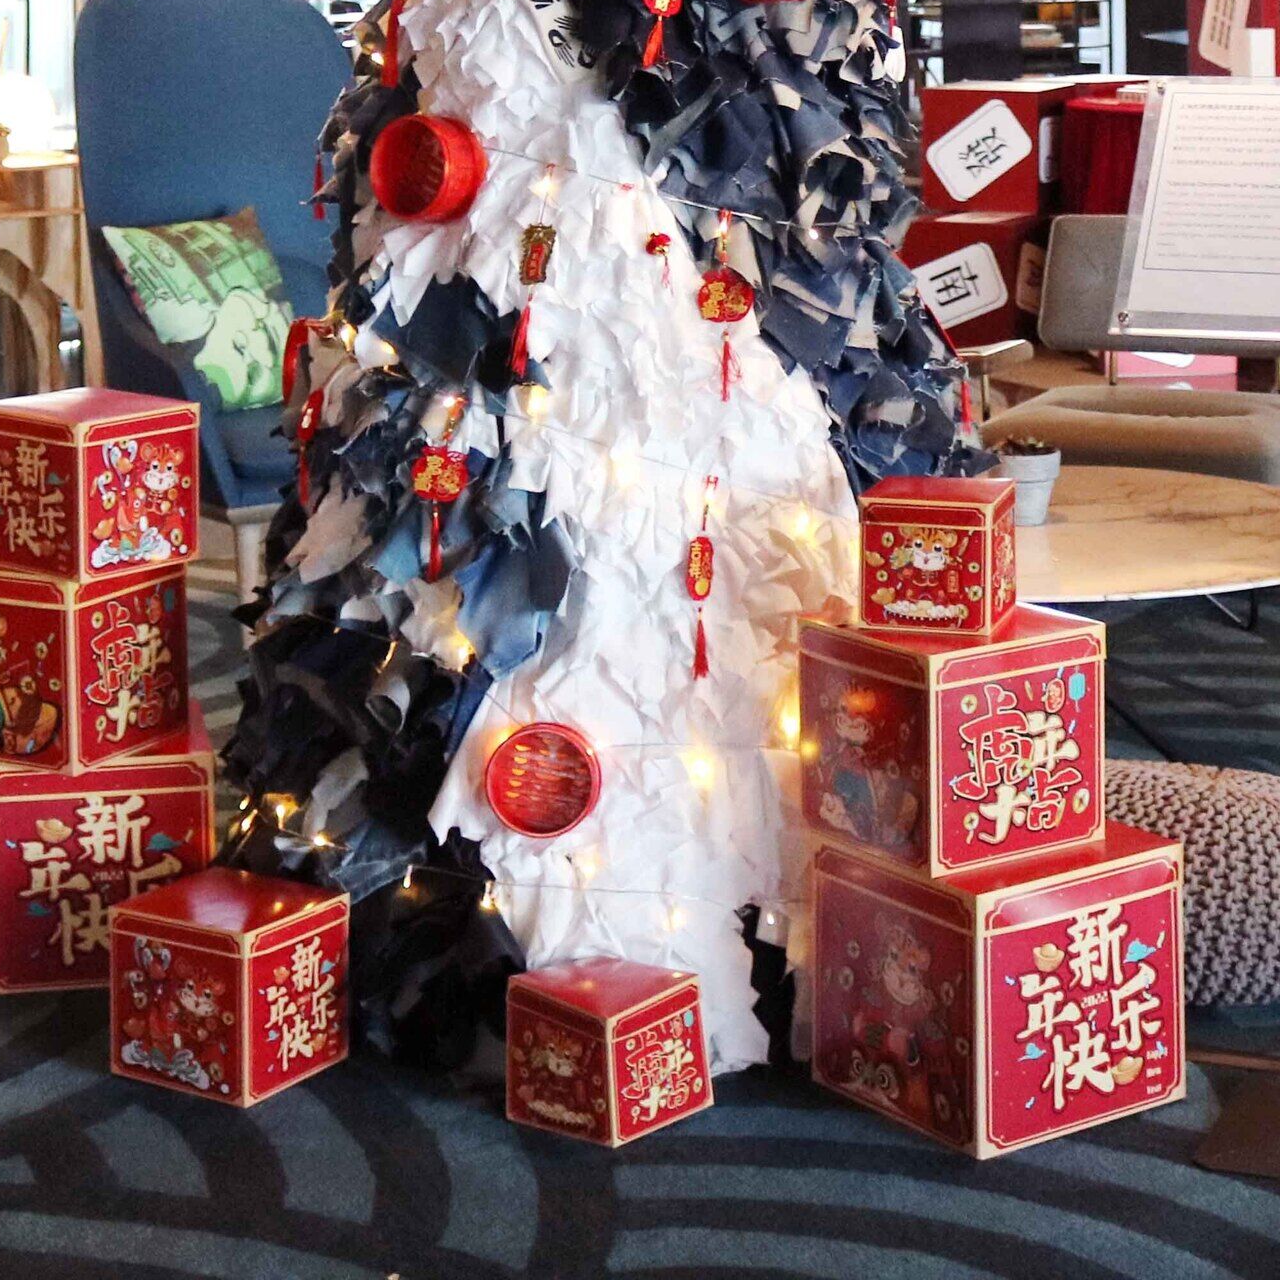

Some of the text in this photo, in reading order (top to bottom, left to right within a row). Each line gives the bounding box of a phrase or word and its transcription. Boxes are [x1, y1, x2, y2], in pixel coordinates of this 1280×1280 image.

[928, 260, 981, 308] 南
[1017, 904, 1161, 1110] 新年快乐
